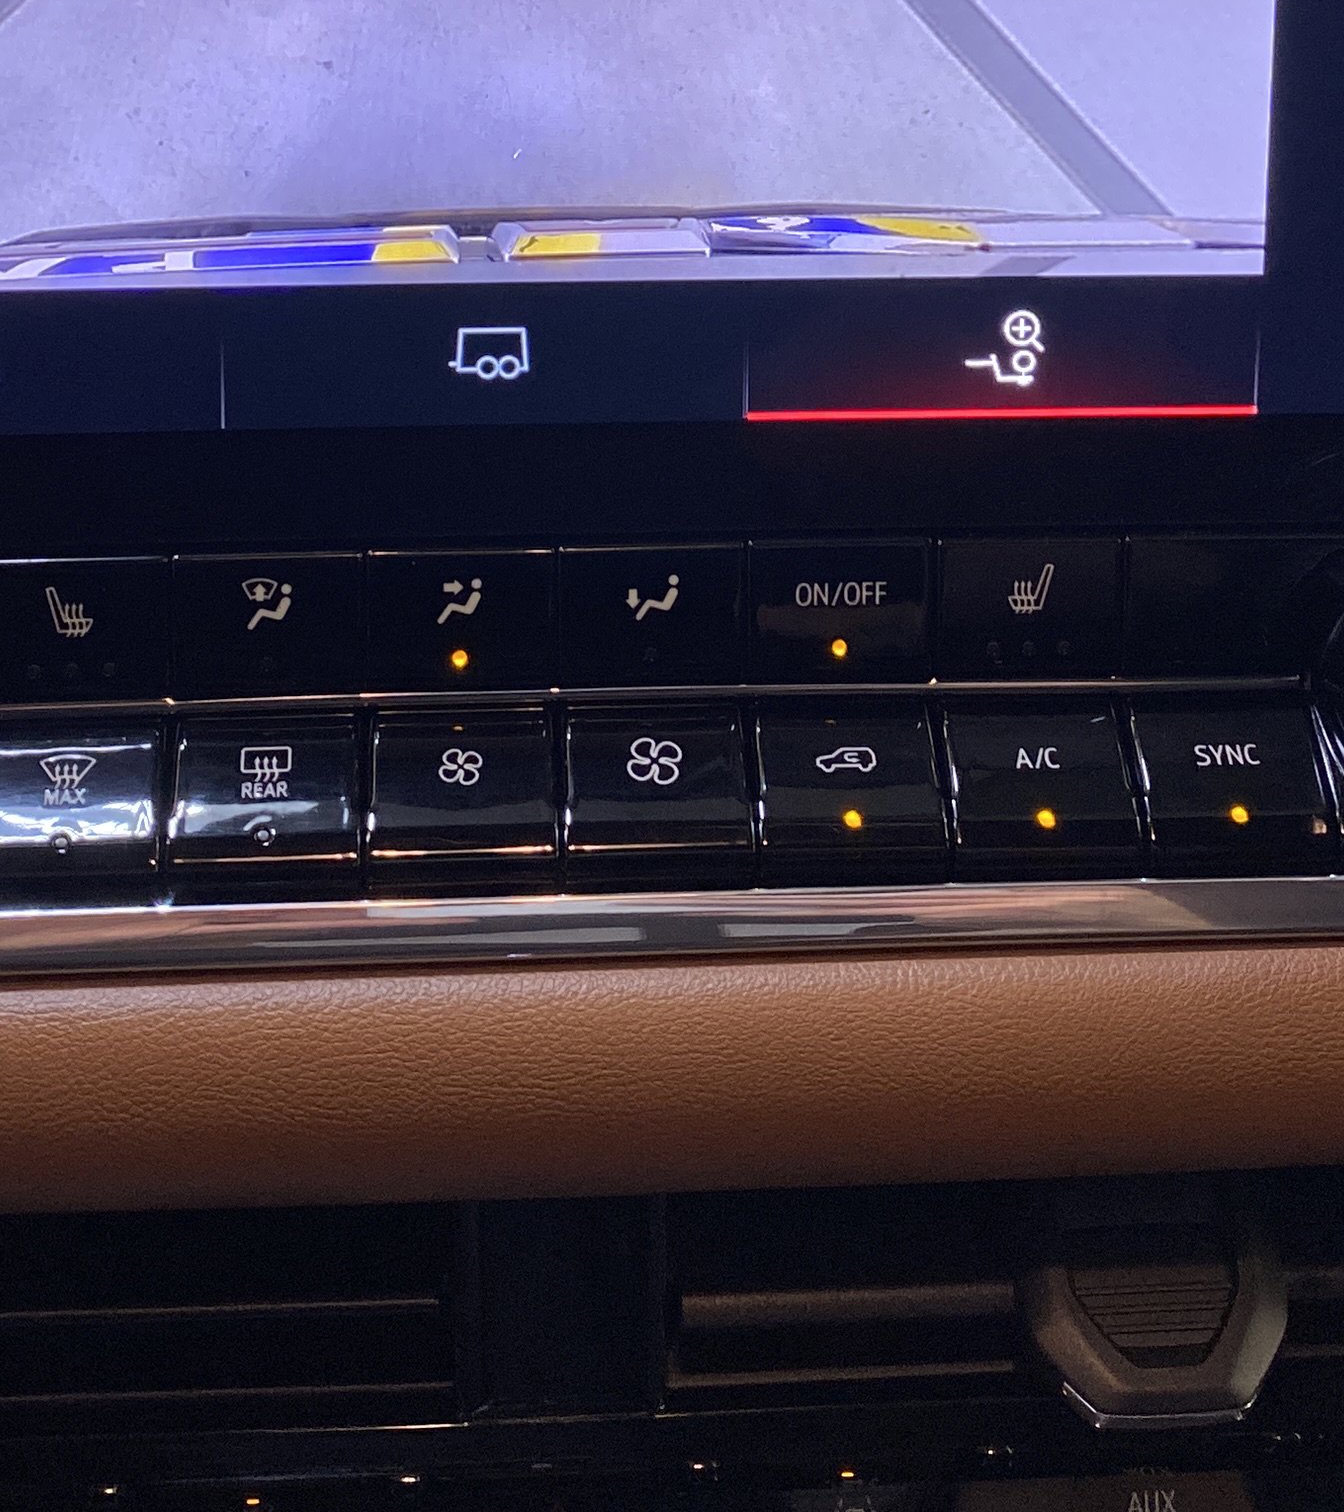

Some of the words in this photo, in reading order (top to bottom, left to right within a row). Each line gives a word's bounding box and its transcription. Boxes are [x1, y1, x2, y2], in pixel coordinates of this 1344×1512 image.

[795, 580, 888, 607] ON/OFF
[1015, 746, 1060, 770] A/C
[1193, 743, 1261, 768] SYNC
[42, 788, 87, 807] MAX
[240, 781, 289, 800] REAR
